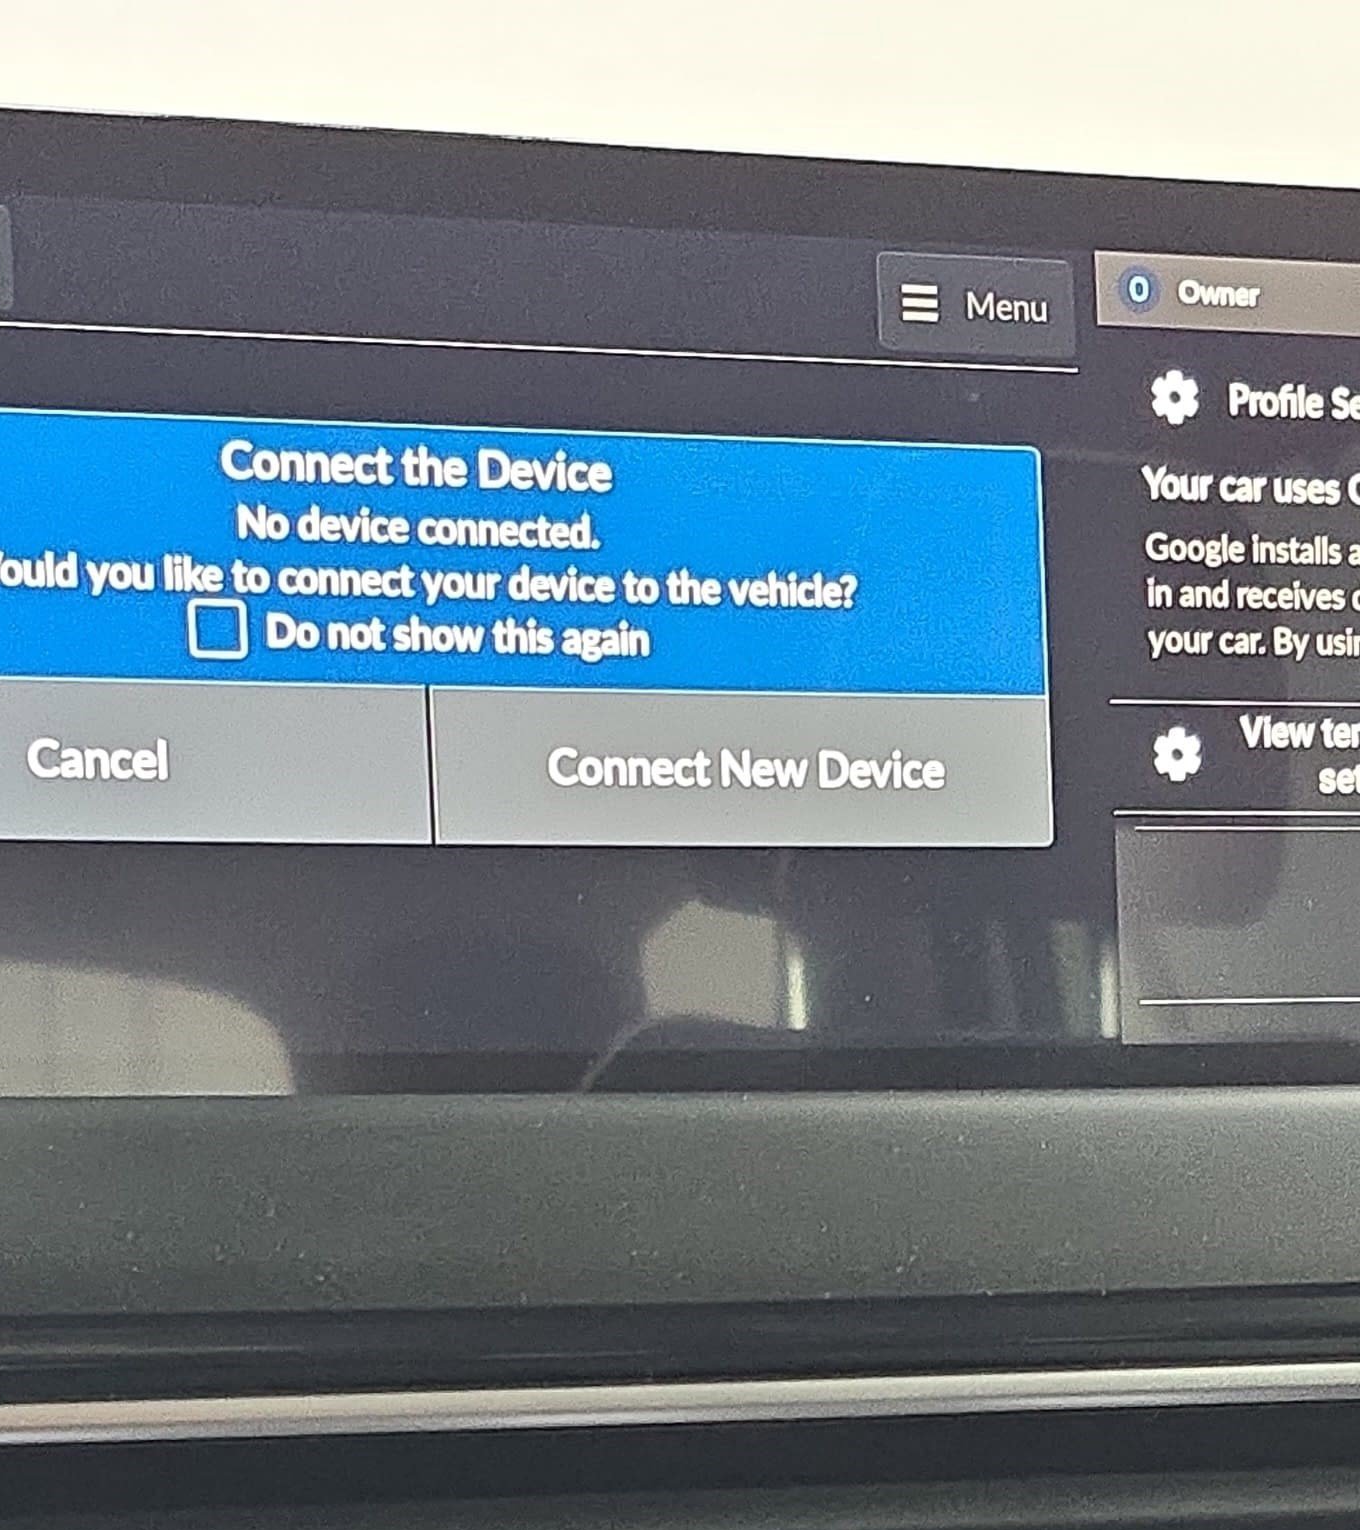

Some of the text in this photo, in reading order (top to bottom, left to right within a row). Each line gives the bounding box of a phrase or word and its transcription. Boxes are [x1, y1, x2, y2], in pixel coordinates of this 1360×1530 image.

[965, 291, 1048, 323] Menu
[1177, 278, 1261, 308] Owner
[1227, 382, 1324, 420] Profile
[220, 440, 614, 493] Connect the Device
[1141, 465, 1213, 502] Your
[1219, 474, 1267, 503] car
[1273, 478, 1341, 506] uses
[237, 503, 602, 550] No device connected.
[1145, 532, 1245, 567] Google
[1251, 533, 1342, 566] installs
[85, 560, 155, 596] you
[163, 553, 223, 592] like
[232, 558, 271, 594] to
[278, 562, 415, 599] connect
[420, 569, 502, 606] your
[508, 564, 616, 604] device
[622, 569, 660, 606] to
[666, 568, 723, 606] the
[728, 570, 859, 610] vehicle?
[1147, 577, 1173, 608] in
[1179, 578, 1231, 611] and
[1236, 580, 1345, 613] receives
[265, 612, 651, 664] Do not show this again
[1147, 627, 1214, 661] your
[1219, 632, 1267, 657] car.
[1273, 626, 1310, 663] By
[1239, 714, 1316, 750] View
[26, 737, 170, 782] Cancel
[547, 747, 948, 792] Connect New Device
